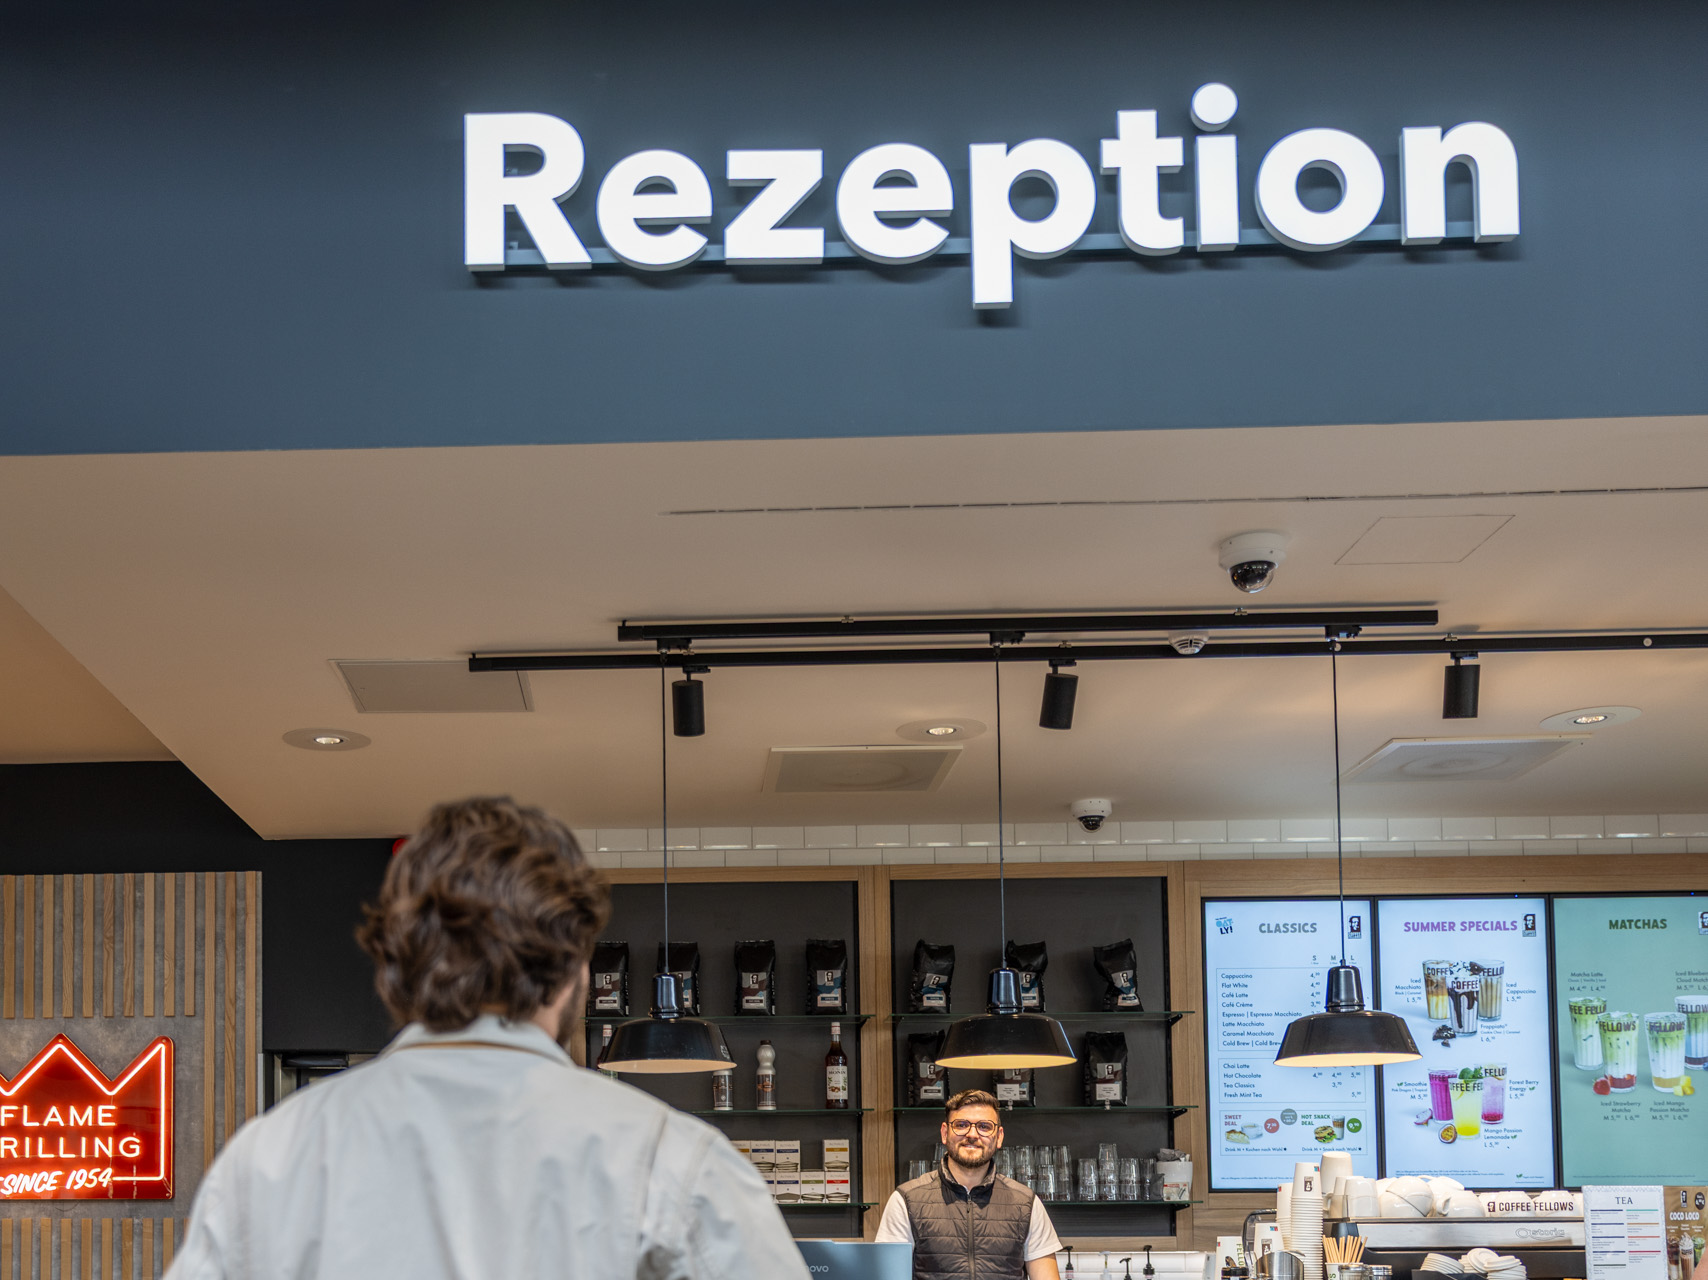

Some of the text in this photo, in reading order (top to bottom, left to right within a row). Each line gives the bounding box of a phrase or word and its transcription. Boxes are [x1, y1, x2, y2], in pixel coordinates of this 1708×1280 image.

[463, 81, 1521, 310] Rezeption
[1258, 922, 1318, 934] CLASSICS
[1403, 920, 1518, 932] SUMMER SPECIALS
[1608, 918, 1668, 930] MATCHAS
[1426, 966, 1449, 976] COFFE
[1221, 973, 1253, 981] Cappuccino
[1451, 980, 1479, 990] COFFEE
[1222, 1011, 1302, 1019] Espresso Espresso Macchiato
[0, 1105, 117, 1126] FLAME
[0, 1136, 141, 1158] RILLING
[1, 1167, 113, 1195] SINCE 1954
[1614, 1196, 1634, 1205] TEA
[1498, 1201, 1574, 1212] COFFEE FELLOWS
[1669, 1211, 1700, 1221] COCO LOCO
